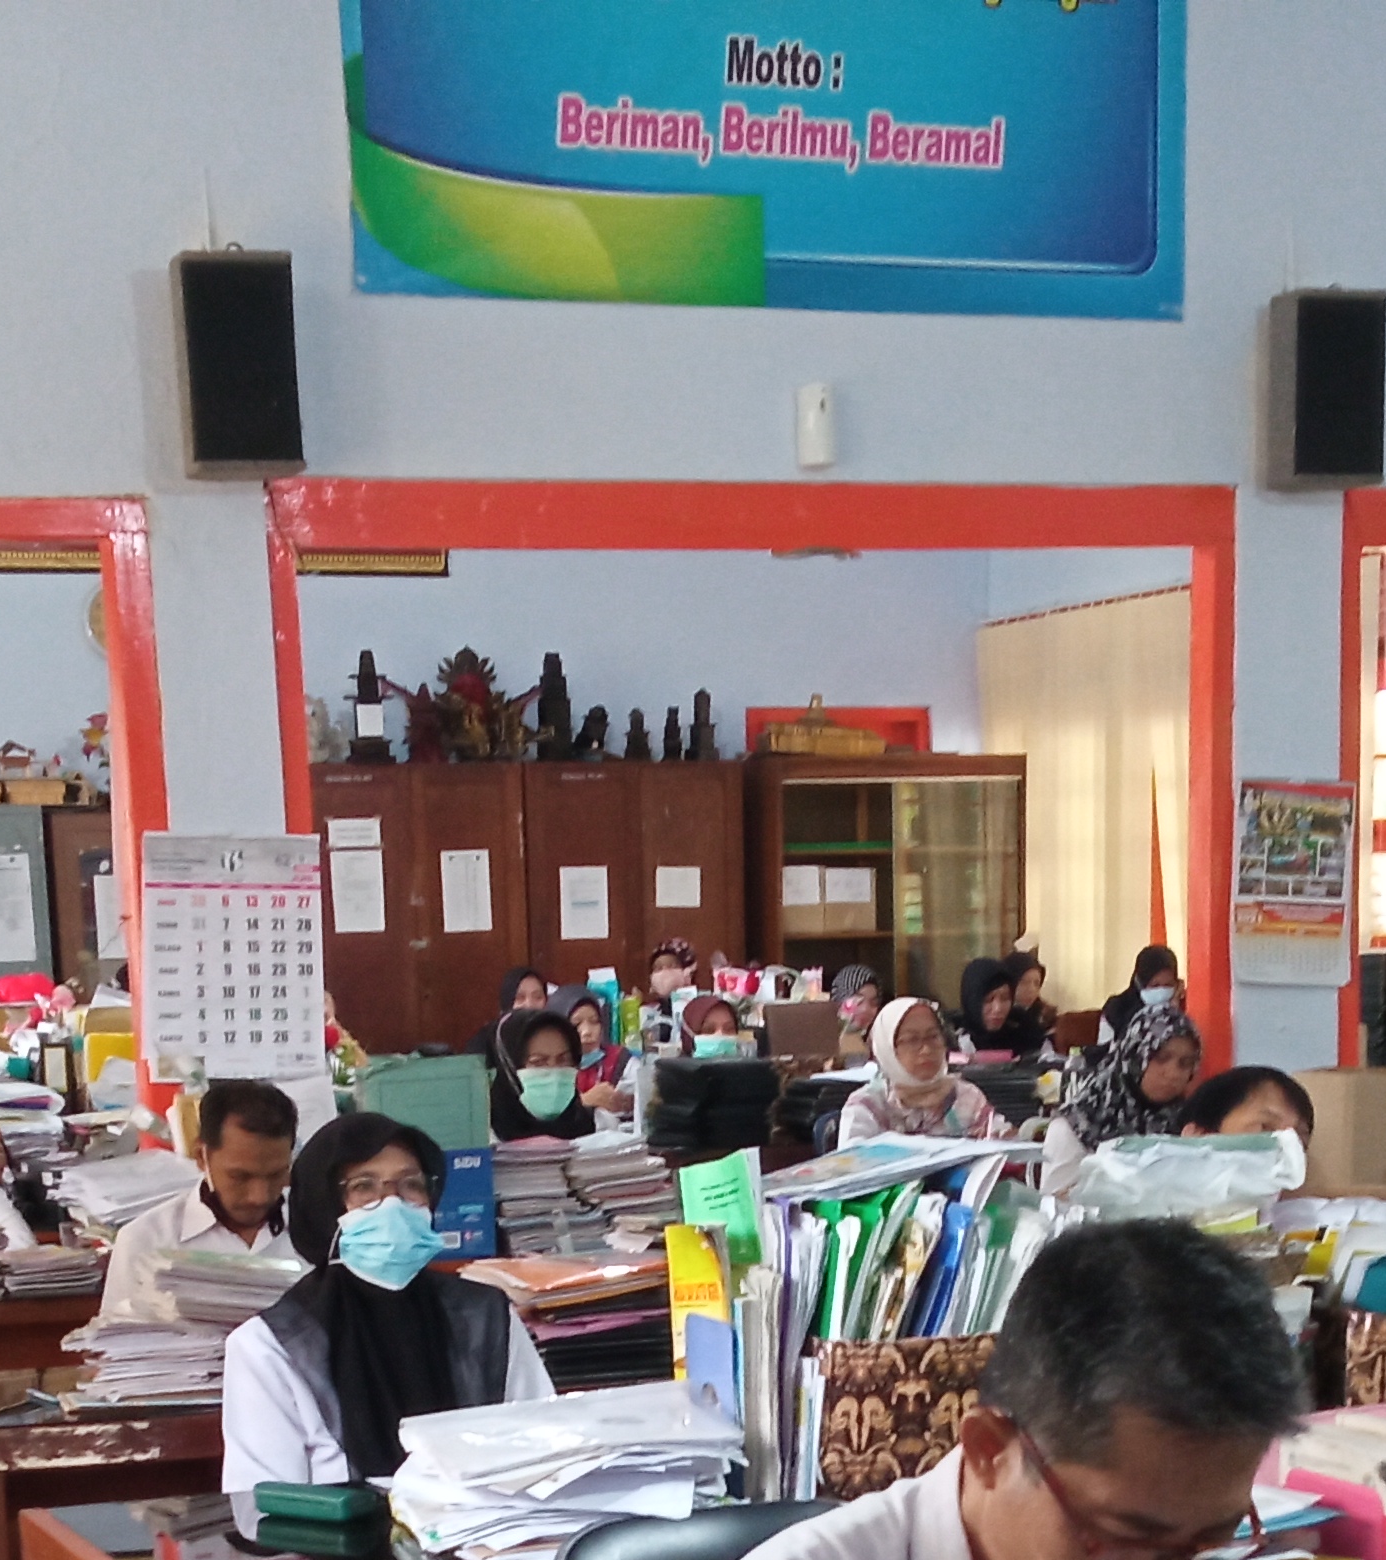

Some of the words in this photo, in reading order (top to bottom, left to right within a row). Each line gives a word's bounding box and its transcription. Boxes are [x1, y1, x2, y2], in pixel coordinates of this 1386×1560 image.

[724, 34, 824, 88] Motto
[558, 94, 711, 164] Beriman,
[721, 103, 859, 171] Berilmu,
[867, 111, 1006, 168] Beramal
[246, 895, 259, 907] 13
[271, 895, 286, 908] 20
[297, 895, 311, 908] 27
[246, 918, 259, 930] 14
[271, 918, 284, 931] 21
[297, 918, 311, 931] 28
[247, 940, 260, 953] 15
[271, 940, 286, 953] 22
[297, 941, 312, 954] 29
[272, 963, 287, 976] 23
[297, 963, 313, 976] 30
[222, 985, 235, 999] 10
[249, 986, 260, 999] 17
[272, 985, 287, 999] 24
[224, 1008, 235, 1021] 11
[272, 1008, 288, 1021] 25
[223, 1031, 236, 1044] 12
[249, 1031, 262, 1043] 19
[272, 1030, 288, 1043] 26
